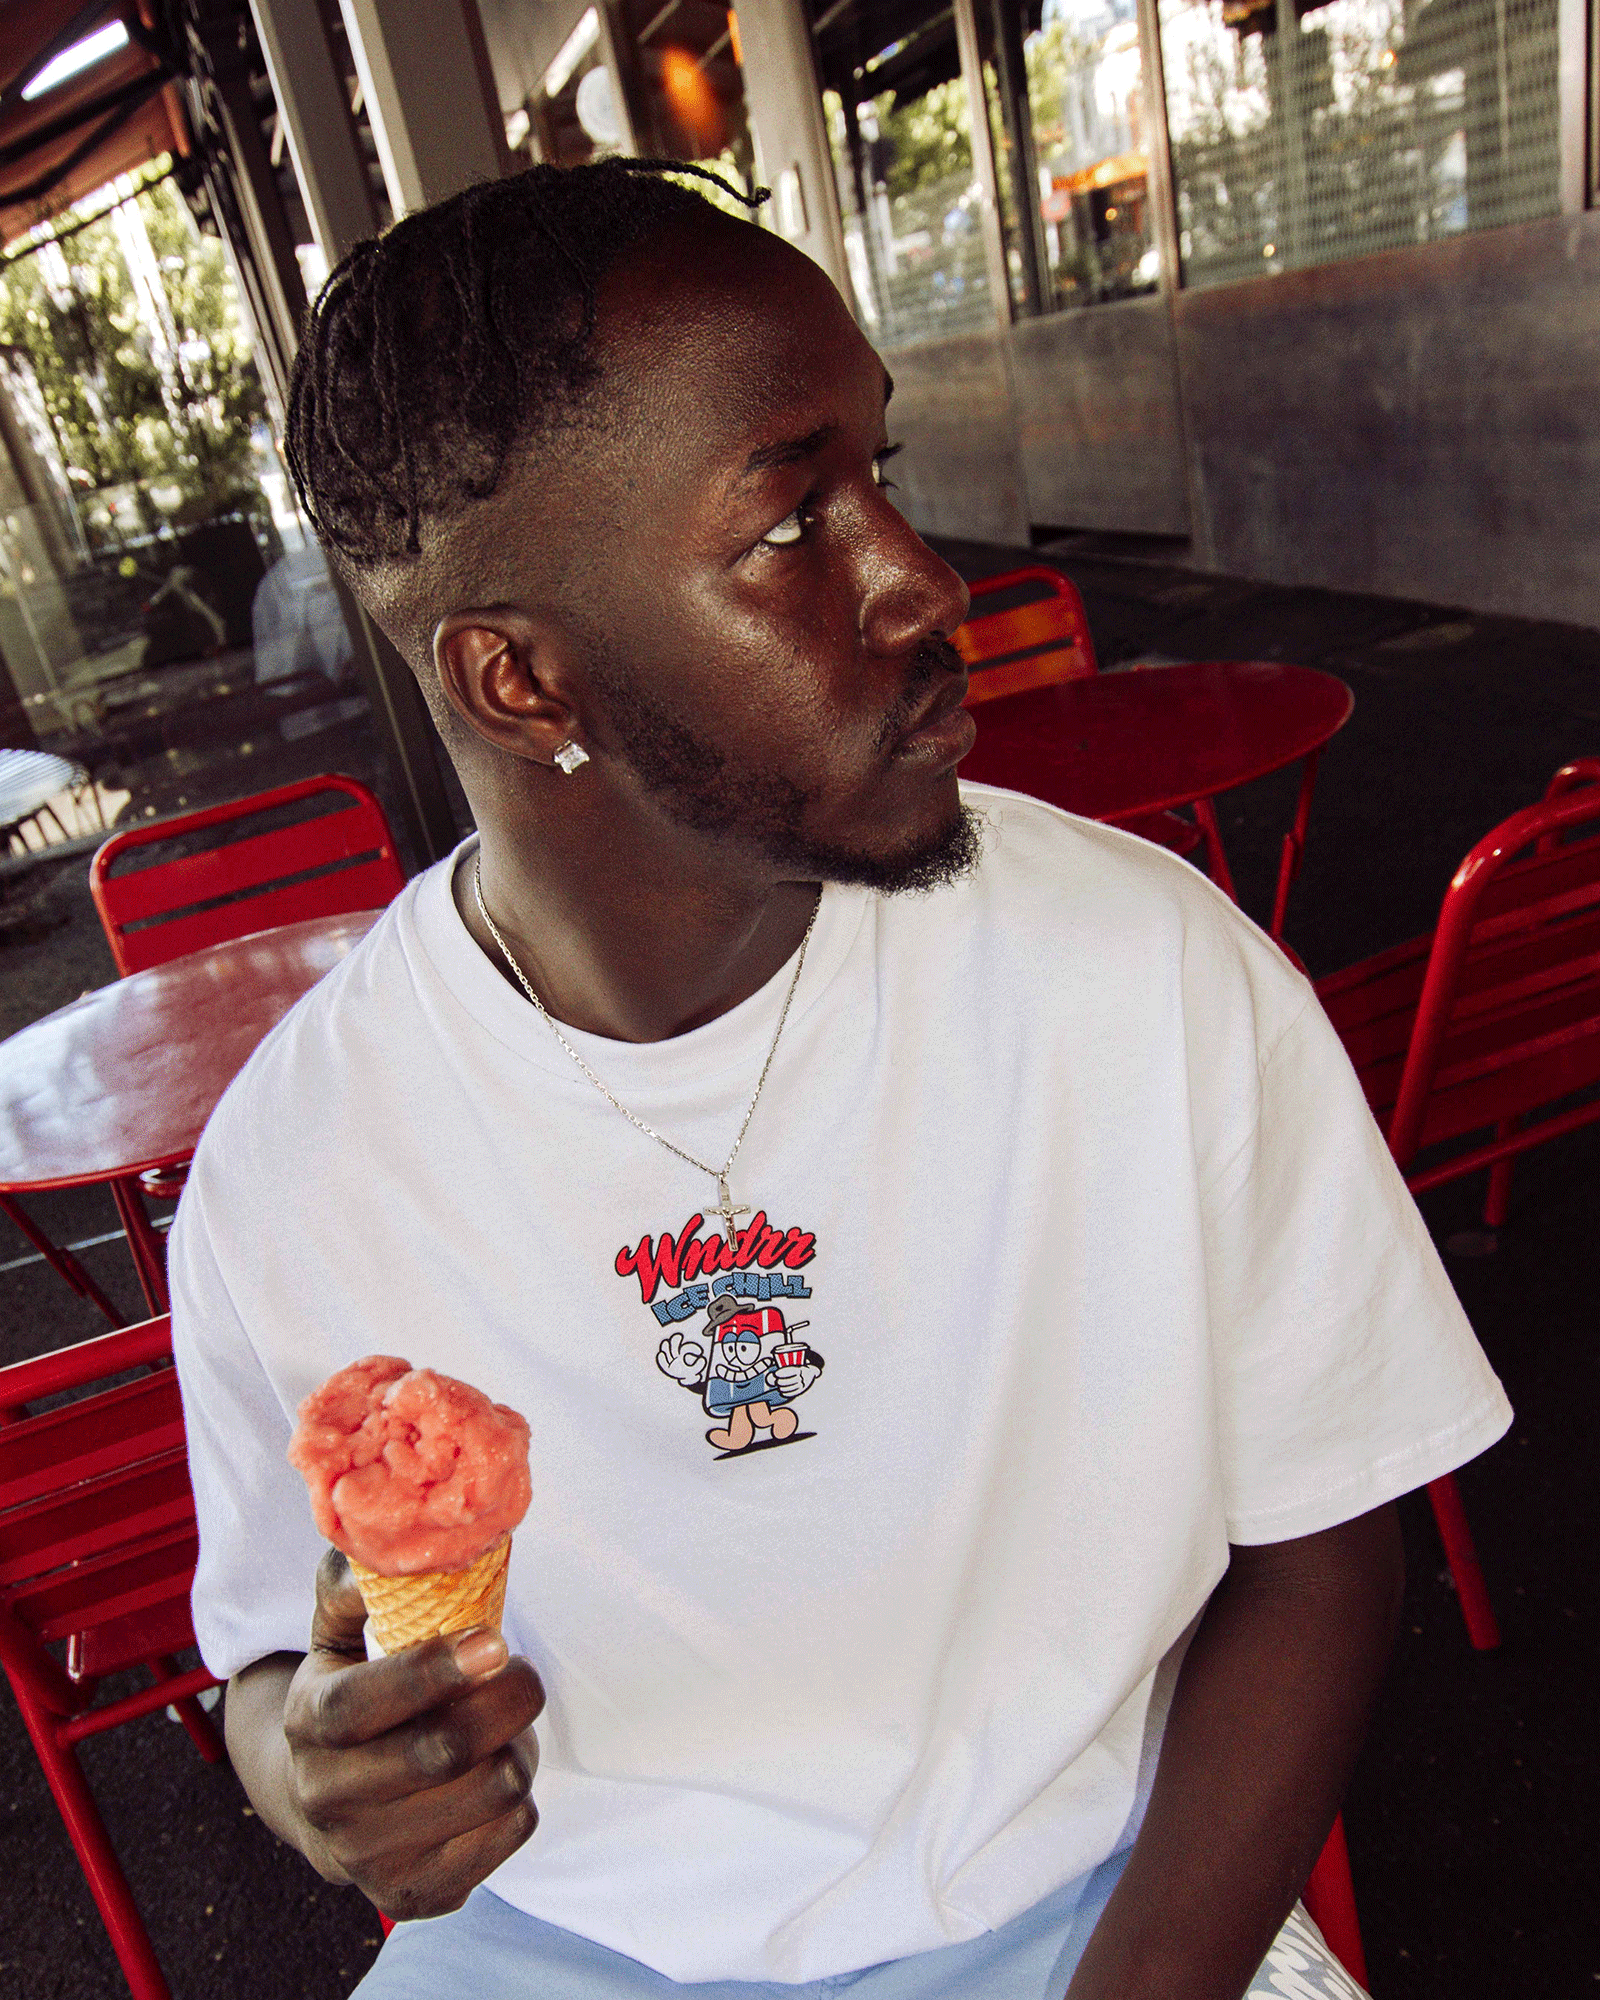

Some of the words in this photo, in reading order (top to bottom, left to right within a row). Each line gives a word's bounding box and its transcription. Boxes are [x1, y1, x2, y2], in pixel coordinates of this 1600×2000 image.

[615, 1210, 817, 1304] Wndrr
[651, 1283, 710, 1327] ICE
[712, 1271, 813, 1301] CHILL
